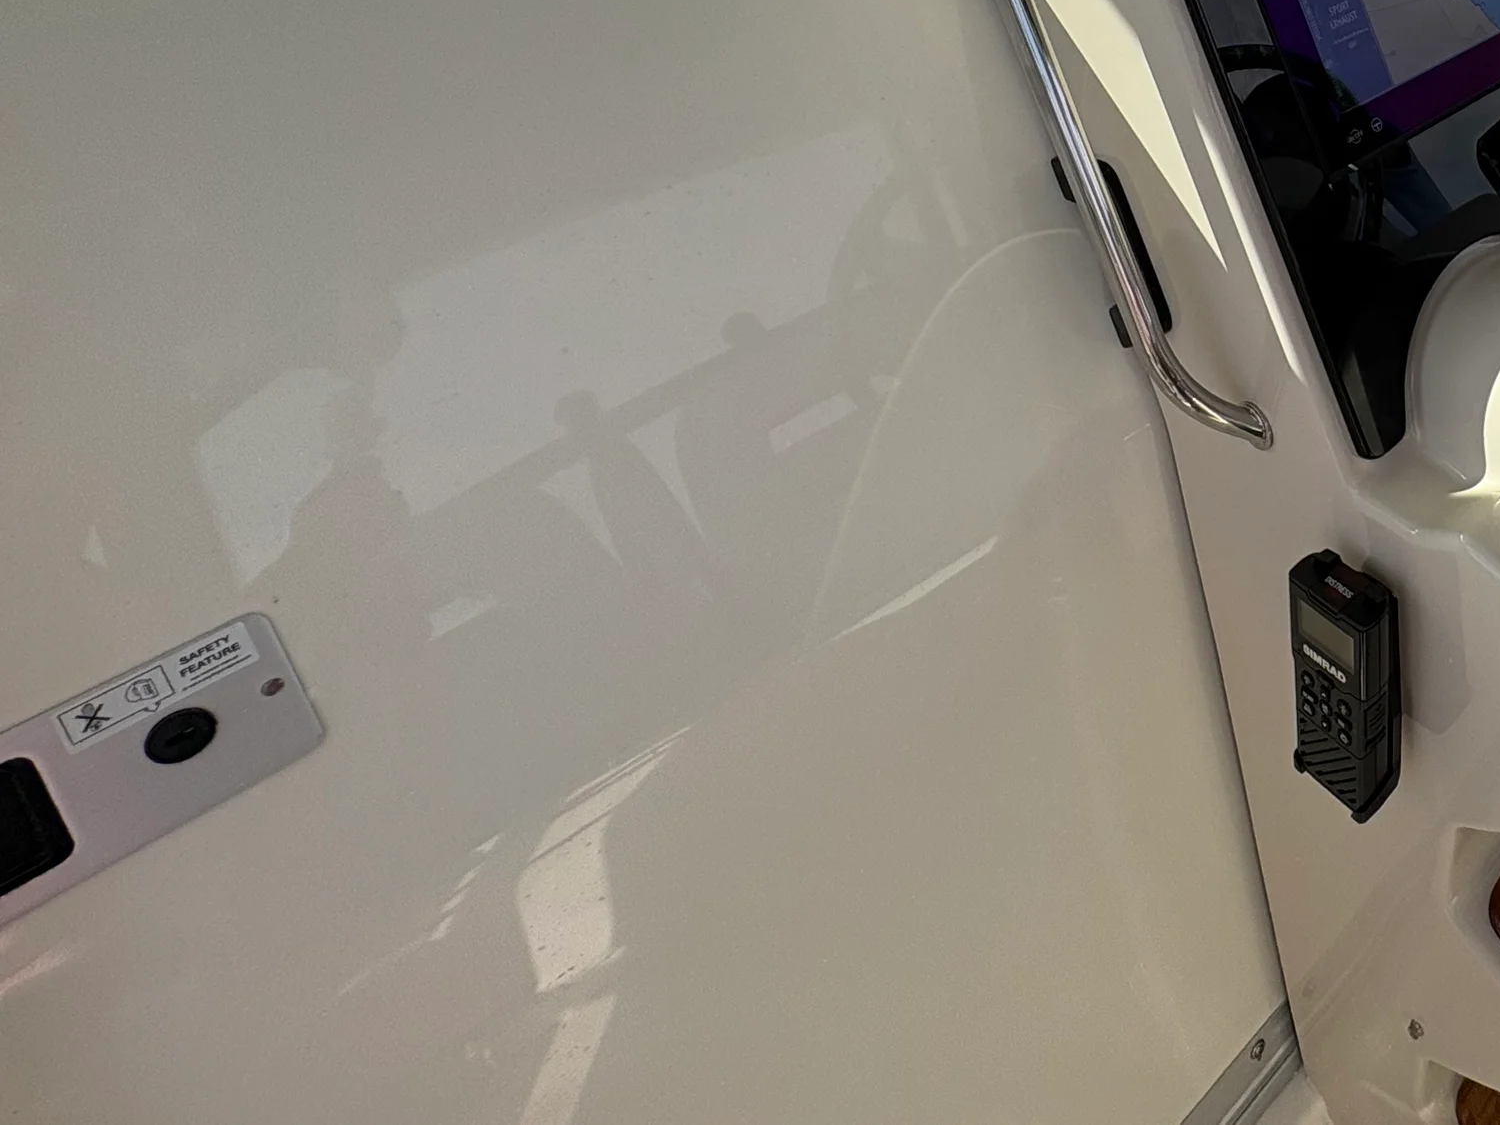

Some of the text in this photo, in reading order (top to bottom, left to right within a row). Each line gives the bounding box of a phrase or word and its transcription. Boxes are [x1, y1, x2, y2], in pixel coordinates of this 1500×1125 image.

[1328, 0, 1349, 16] SPORT
[1329, 11, 1358, 29] EXHAUST
[1324, 576, 1354, 599] DISTRESS
[179, 634, 230, 665] SAFETY
[179, 642, 241, 678] FEATURE
[1303, 643, 1347, 683] SIMRAD
